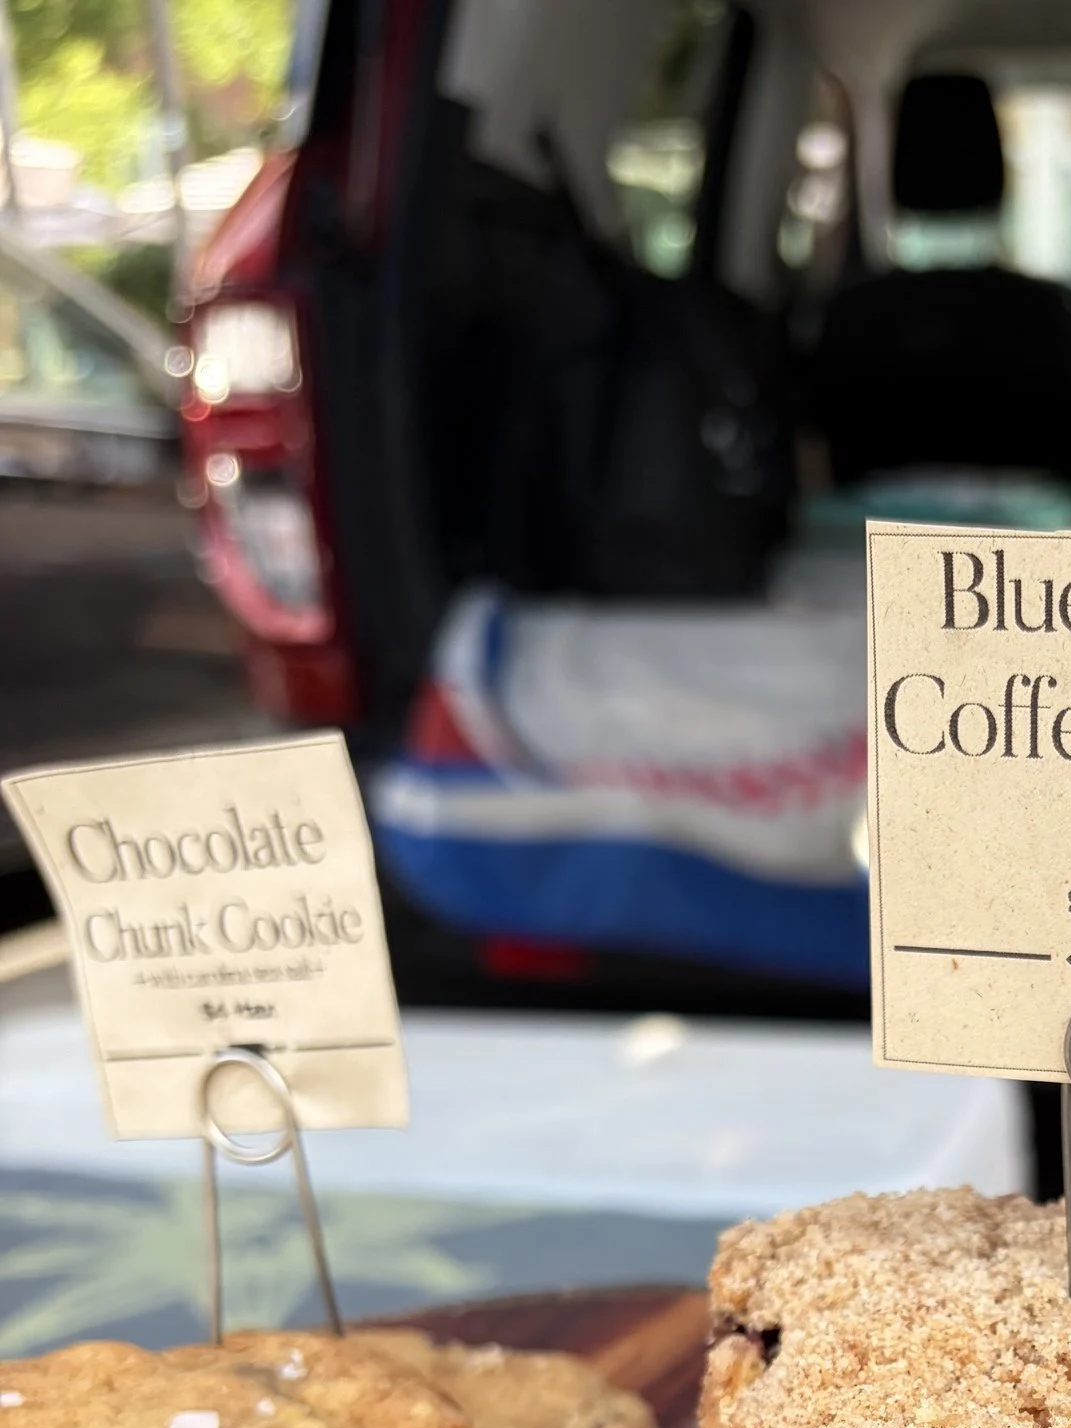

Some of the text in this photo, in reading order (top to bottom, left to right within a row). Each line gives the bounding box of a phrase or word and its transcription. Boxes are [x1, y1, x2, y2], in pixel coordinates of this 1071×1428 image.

[66, 805, 324, 883] Chocolate
[86, 895, 363, 962] Chunk Cookie
